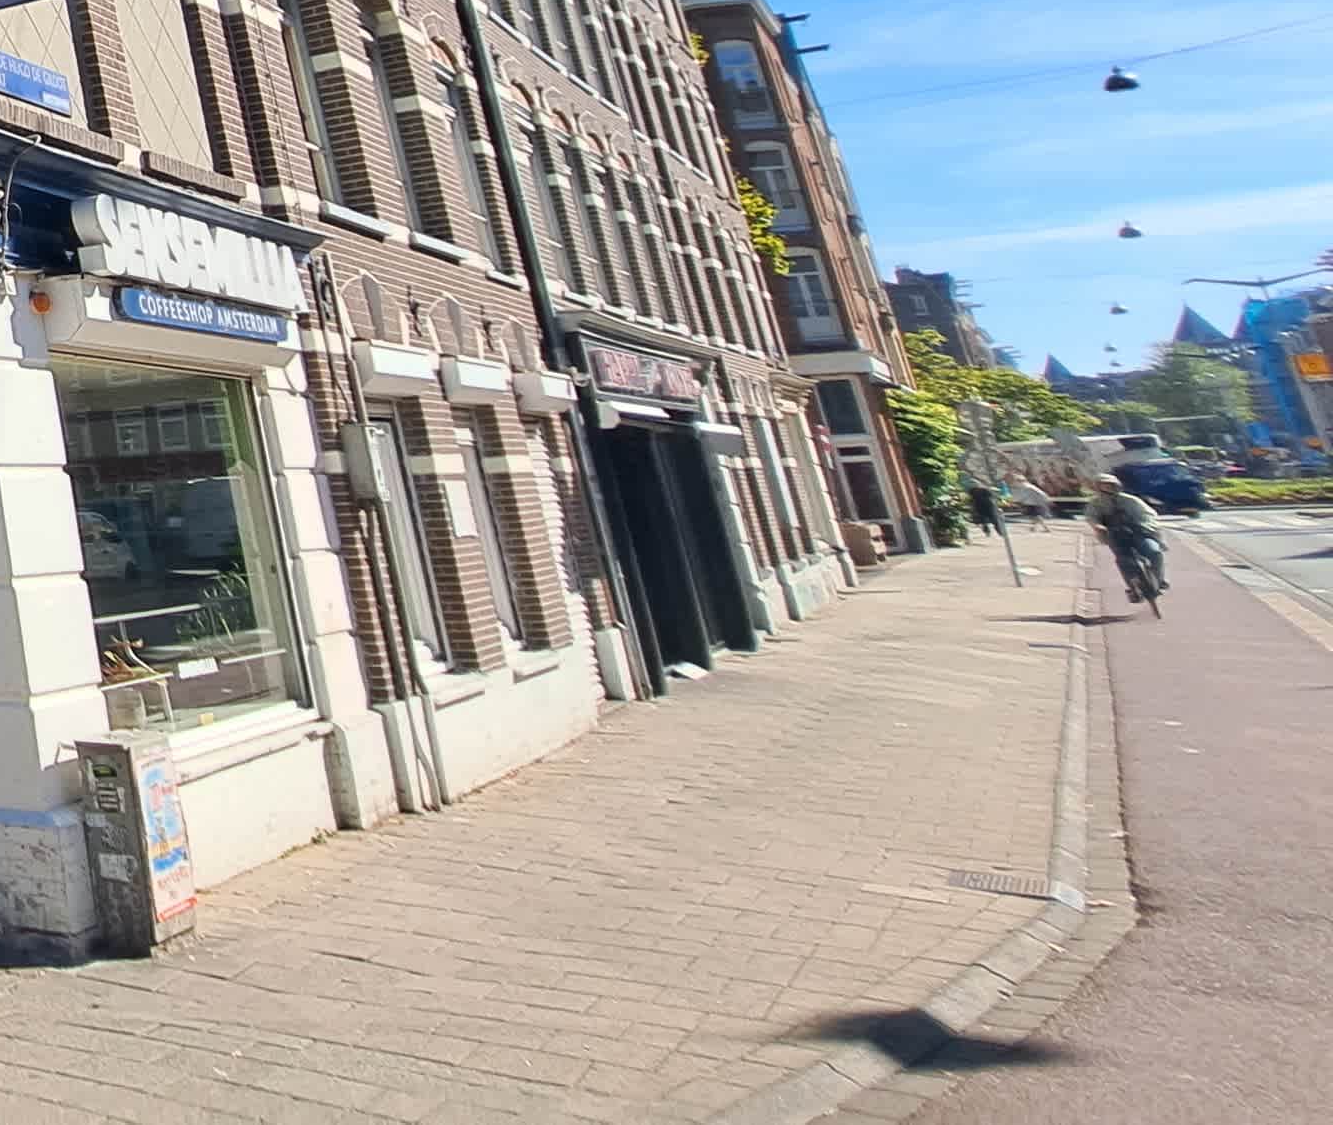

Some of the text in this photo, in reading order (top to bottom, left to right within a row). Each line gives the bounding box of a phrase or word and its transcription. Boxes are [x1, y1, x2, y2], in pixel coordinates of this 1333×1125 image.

[73, 193, 309, 312] SENSEMILLIA
[139, 293, 278, 335] COFFEESHOP AMSTERDAM
